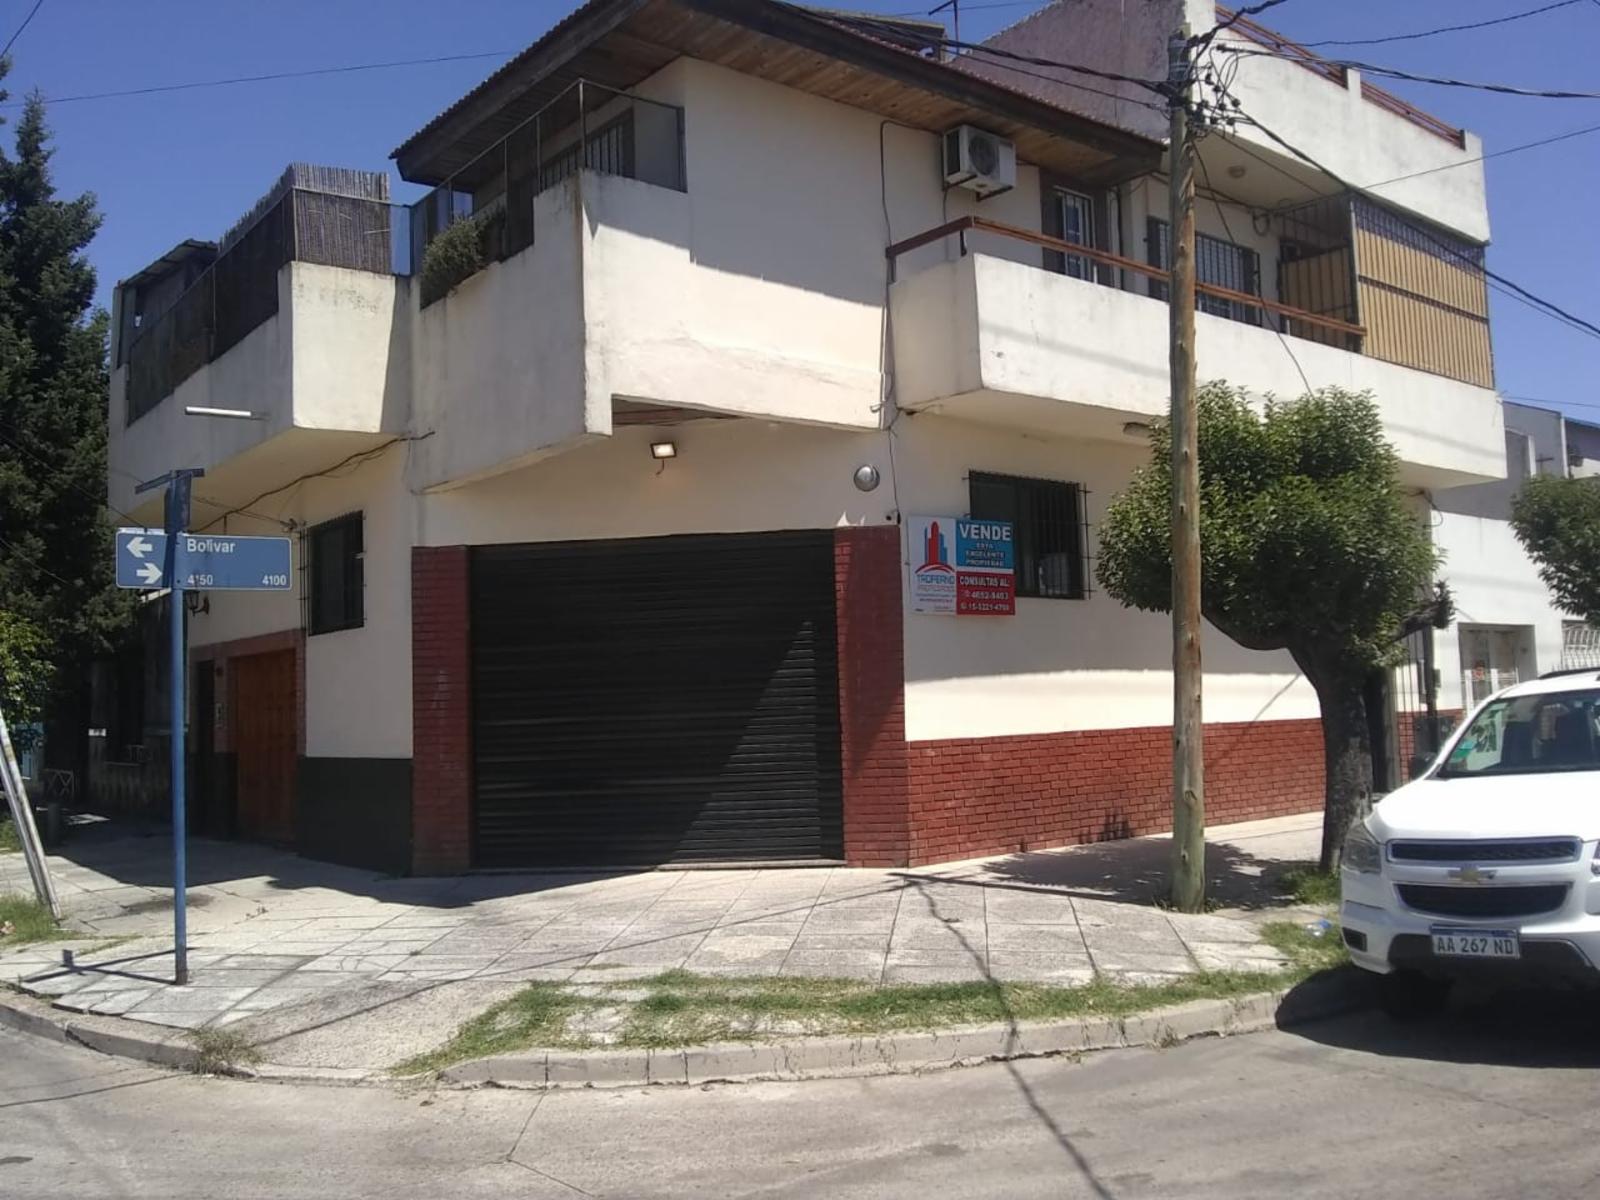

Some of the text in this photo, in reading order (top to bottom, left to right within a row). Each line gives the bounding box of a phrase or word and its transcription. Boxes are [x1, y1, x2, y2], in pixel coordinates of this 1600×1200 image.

[959, 523, 1012, 541] VENDE
[262, 575, 287, 586] 4100
[960, 575, 999, 587] CONSULTAS
[1438, 937, 1514, 955] AA 267 ND
